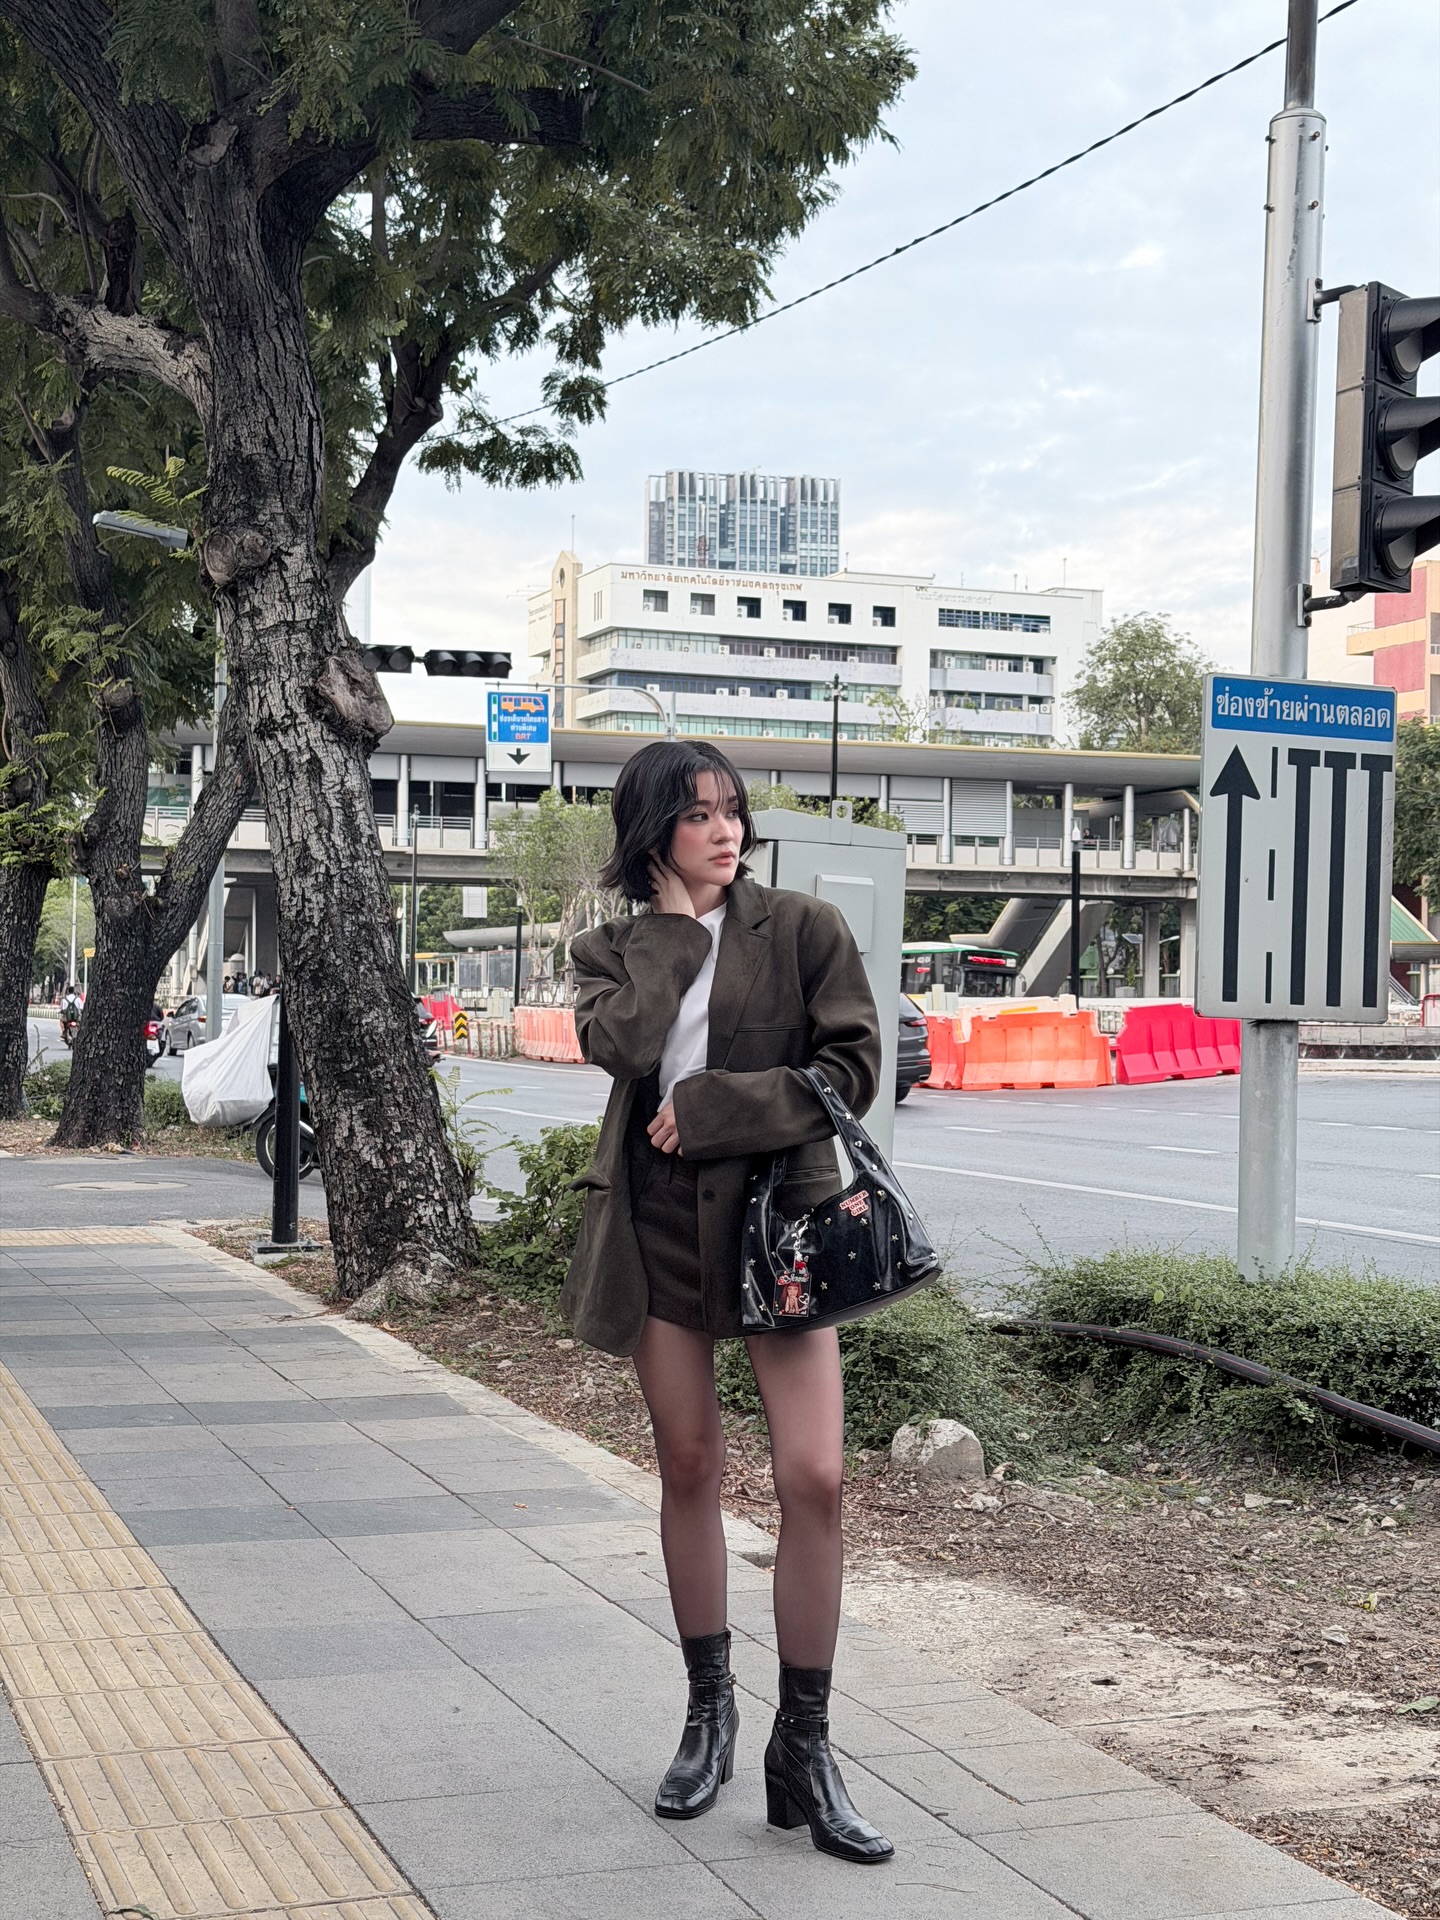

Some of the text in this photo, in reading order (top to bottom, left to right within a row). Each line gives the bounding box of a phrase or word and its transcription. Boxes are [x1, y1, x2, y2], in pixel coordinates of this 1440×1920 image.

[620, 569, 803, 594] มหาวิทยาลัยเทคโนโลยีราชมงคลกรุงเทพ
[1216, 686, 1391, 729] ช่องซ้ายผ่านตลอด
[840, 1191, 868, 1209] NUMBER
[850, 1200, 864, 1210] ONE
[852, 1205, 868, 1216] GIRL
